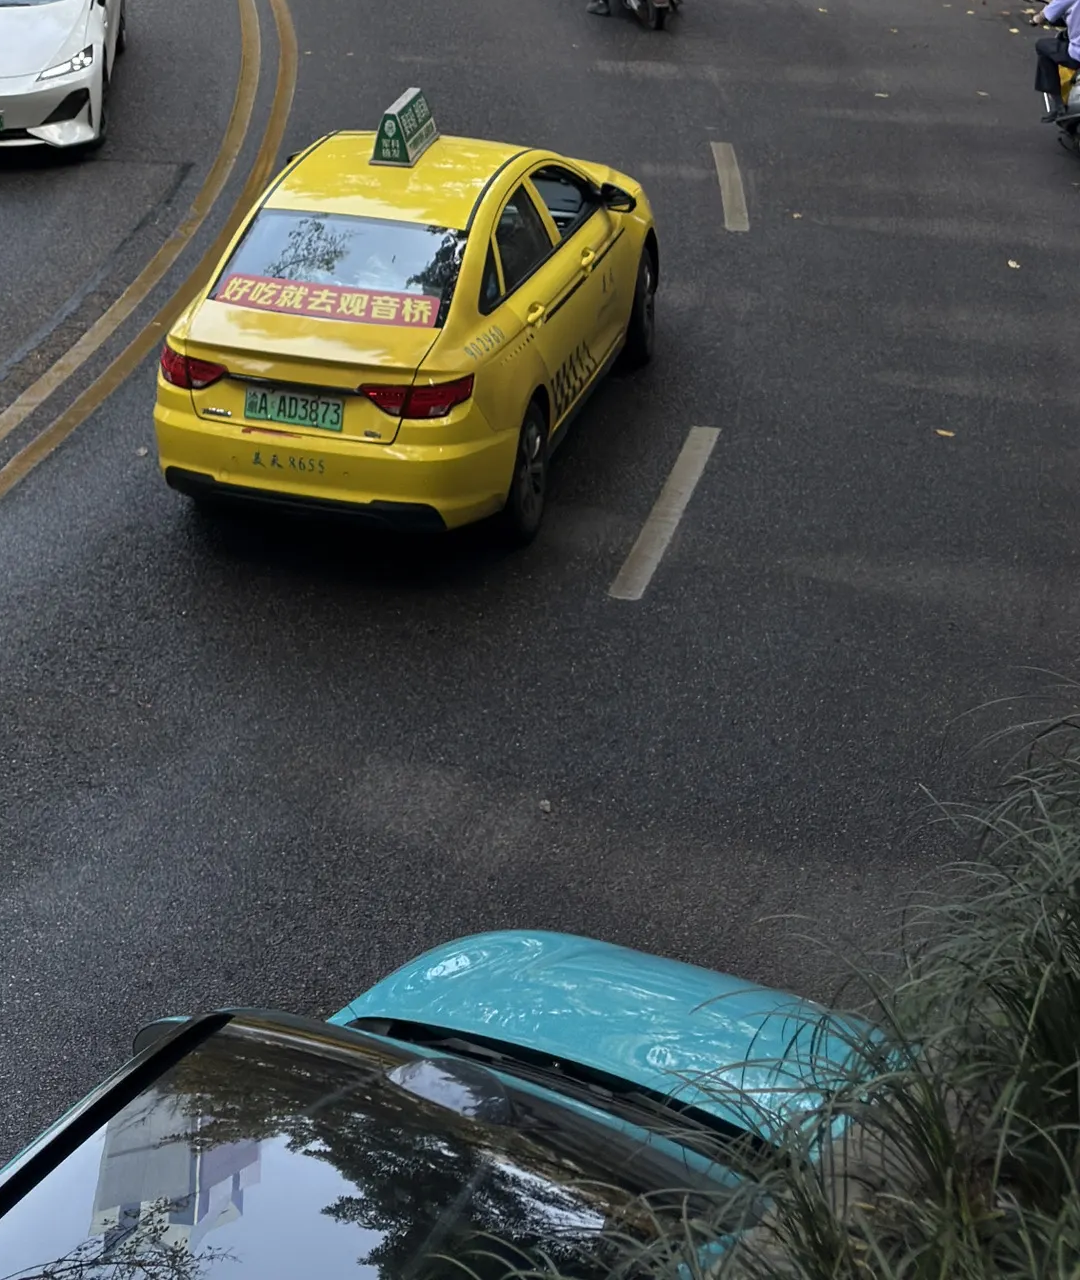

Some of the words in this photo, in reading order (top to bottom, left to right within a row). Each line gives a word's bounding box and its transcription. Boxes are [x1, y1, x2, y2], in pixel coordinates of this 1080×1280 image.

[220, 276, 433, 325] 好吃就去观音桥
